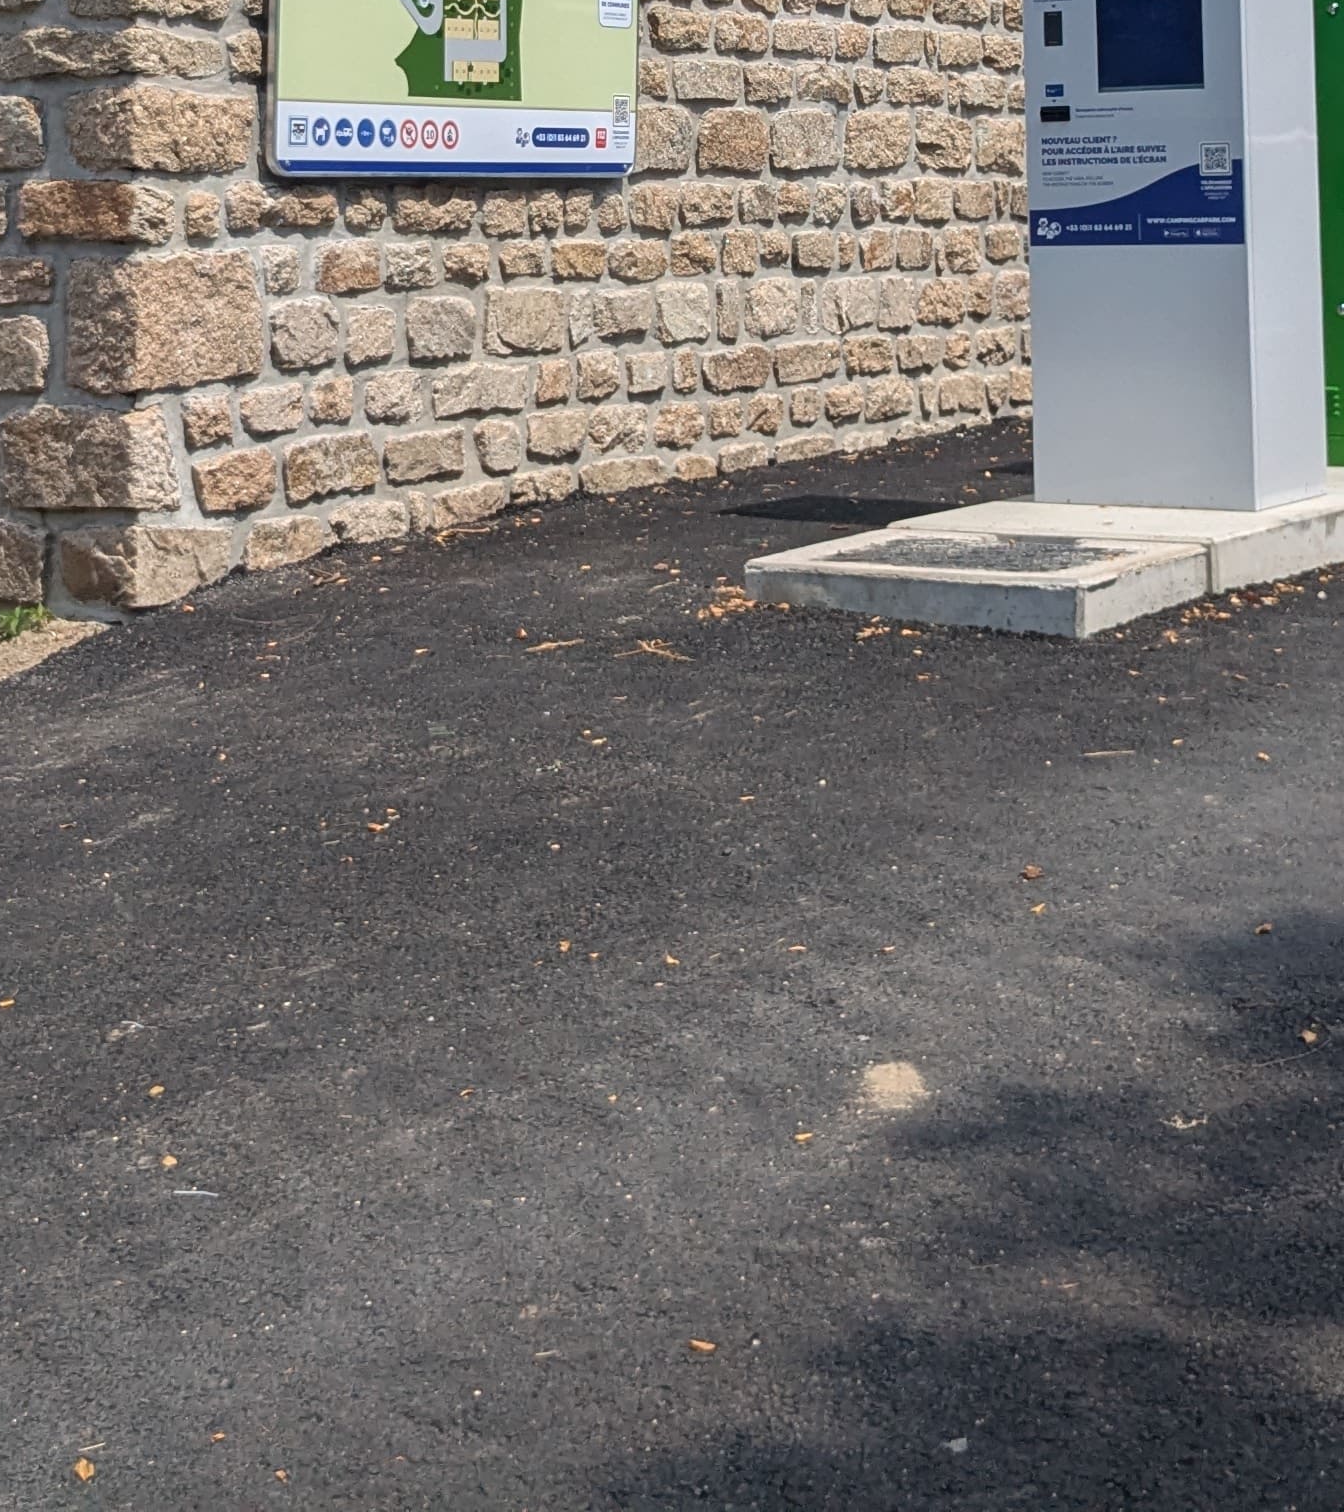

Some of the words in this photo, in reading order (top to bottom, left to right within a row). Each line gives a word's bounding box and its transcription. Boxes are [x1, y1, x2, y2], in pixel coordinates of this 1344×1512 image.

[425, 130, 434, 140] 10
[1082, 136, 1111, 144] CLIENT
[1042, 148, 1064, 156] POUR
[1065, 146, 1102, 155] ACCÉDER
[1137, 145, 1166, 153] SUIVEZ
[1058, 157, 1118, 166] INSTRUCTIONS
[1133, 155, 1166, 163] L'ÉCRAN
